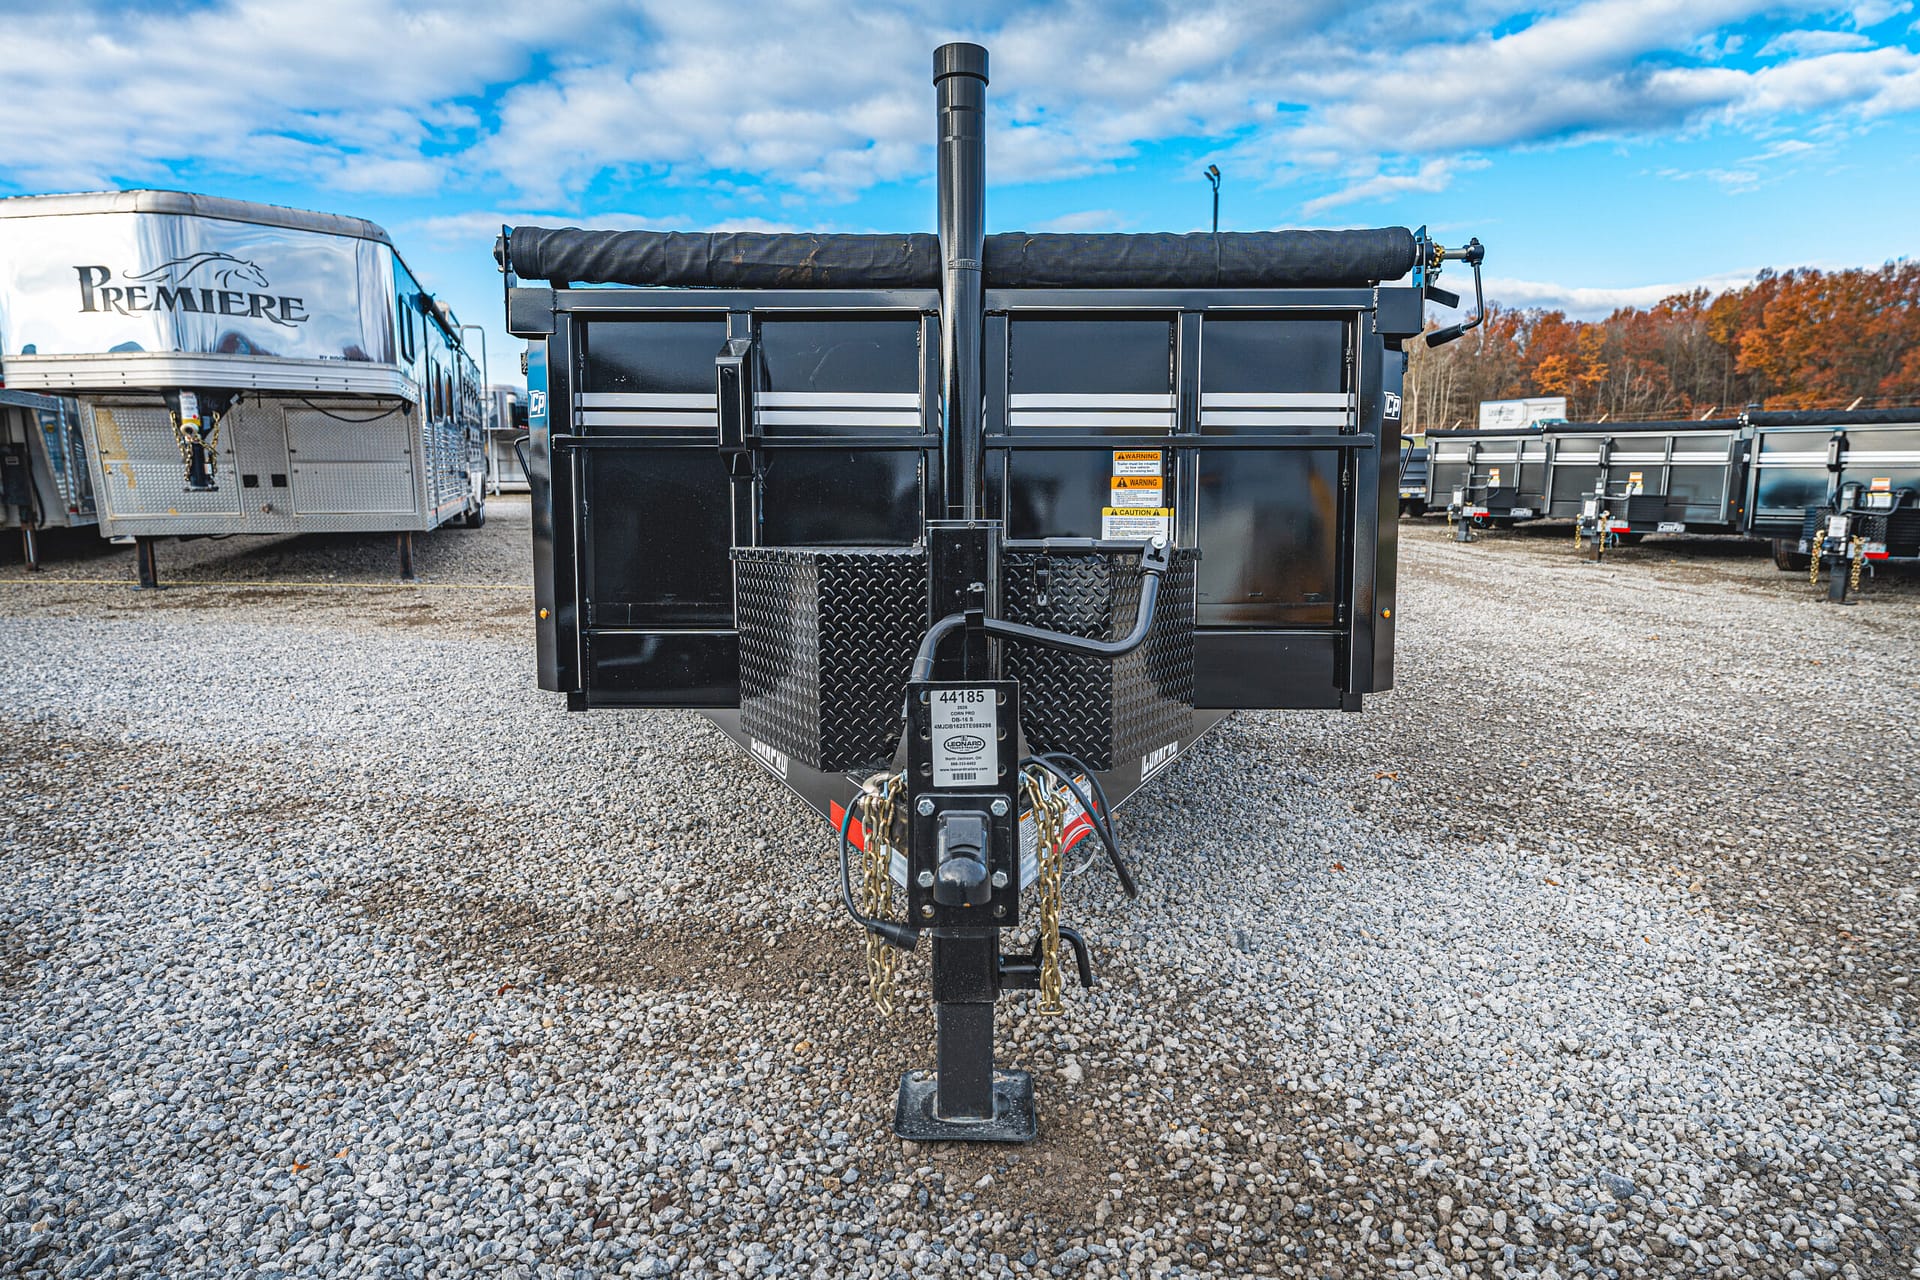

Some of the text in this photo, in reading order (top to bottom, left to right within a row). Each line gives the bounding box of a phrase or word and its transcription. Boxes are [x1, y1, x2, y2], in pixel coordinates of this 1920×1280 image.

[73, 265, 310, 327] PREMIERE
[530, 391, 545, 415] CP
[1385, 393, 1401, 417] CP
[940, 691, 985, 703] 44185
